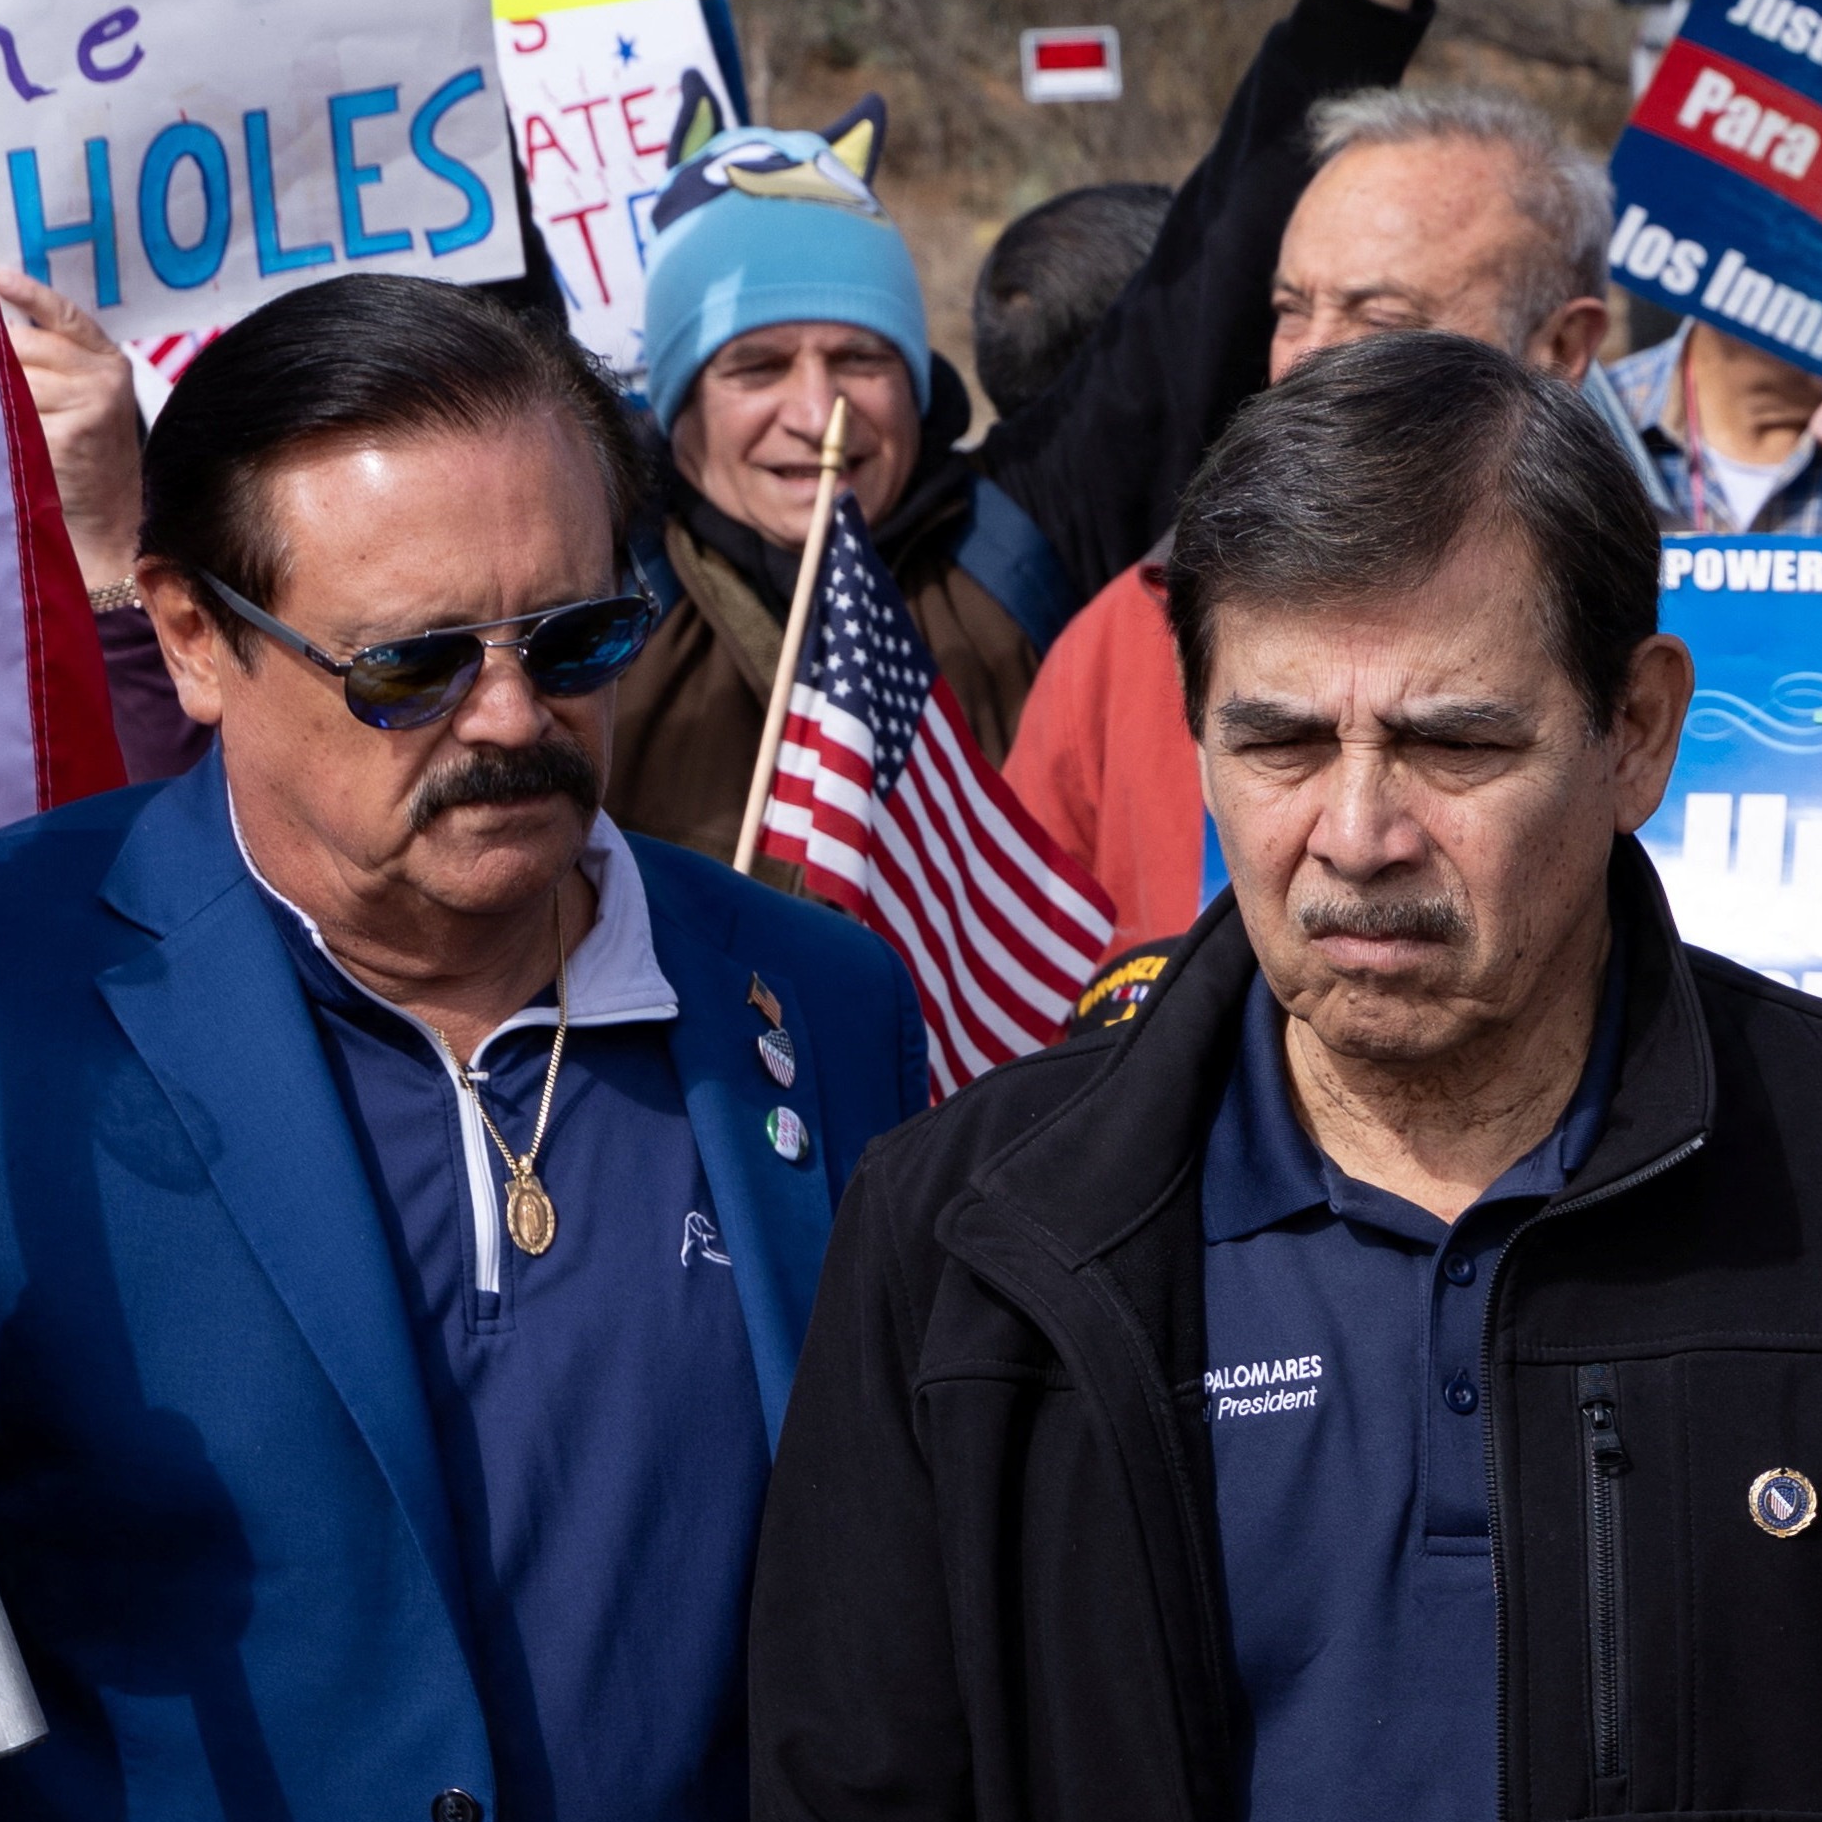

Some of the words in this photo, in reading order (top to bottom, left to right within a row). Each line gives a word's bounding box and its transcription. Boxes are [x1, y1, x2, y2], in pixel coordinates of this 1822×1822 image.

[1678, 66, 1822, 182] Para
[7, 67, 495, 309] HOLES
[1607, 202, 1708, 296] los
[1204, 1354, 1323, 1395] PALOMARES
[1217, 1385, 1319, 1421] President
